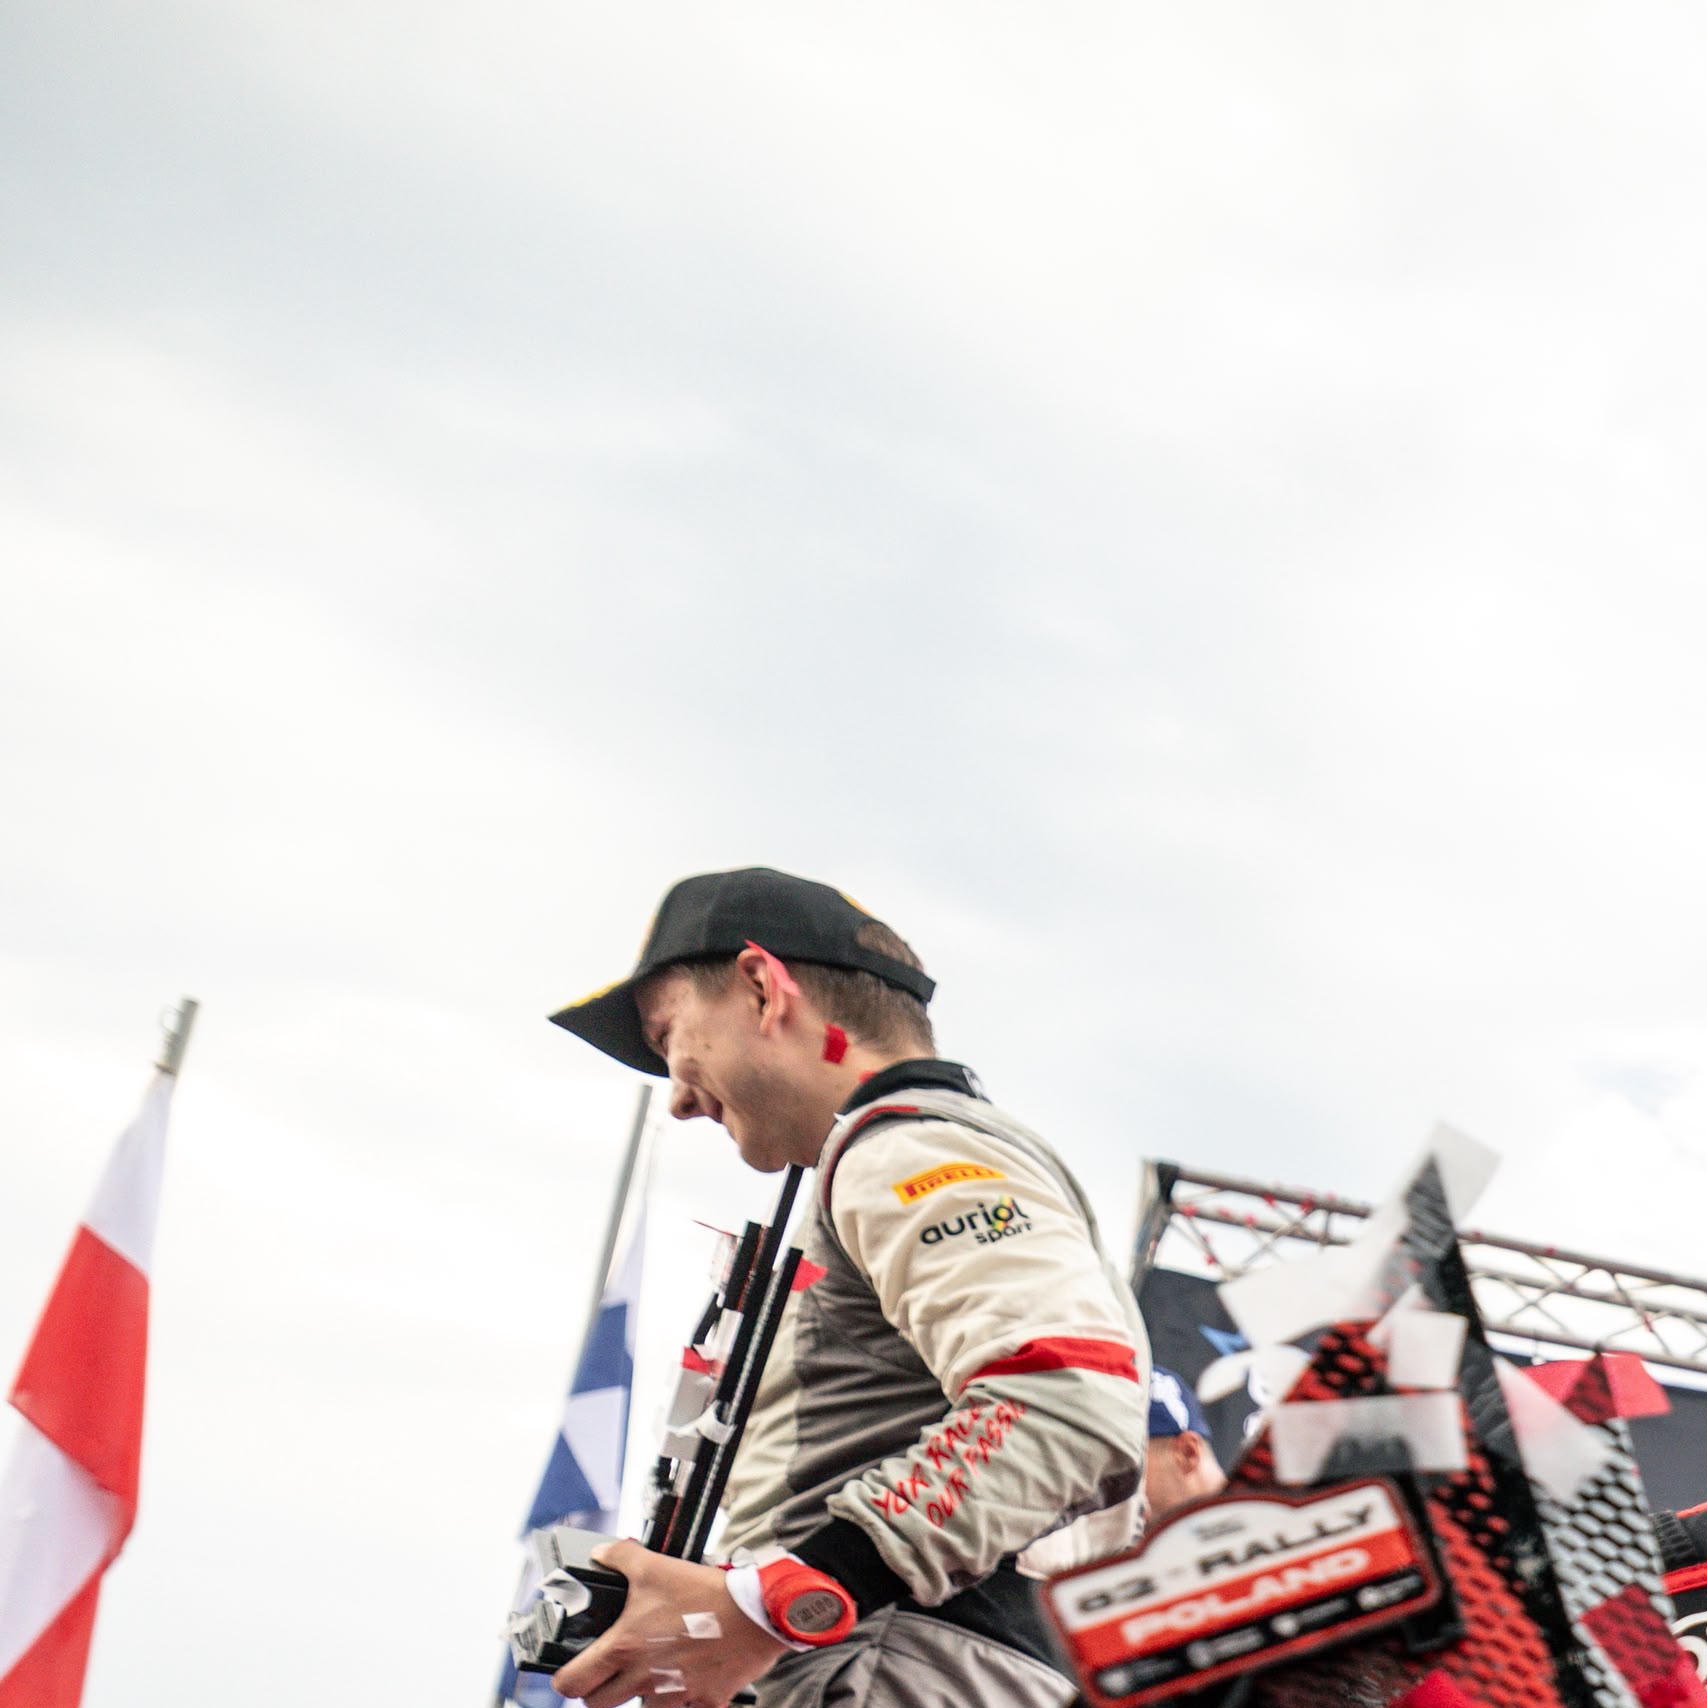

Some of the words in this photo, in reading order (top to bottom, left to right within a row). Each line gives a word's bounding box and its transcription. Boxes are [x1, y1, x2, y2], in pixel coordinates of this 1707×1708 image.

[919, 1196, 1029, 1245] auriol
[1197, 1504, 1375, 1579] RALLY
[1119, 1546, 1373, 1647] POLAND
